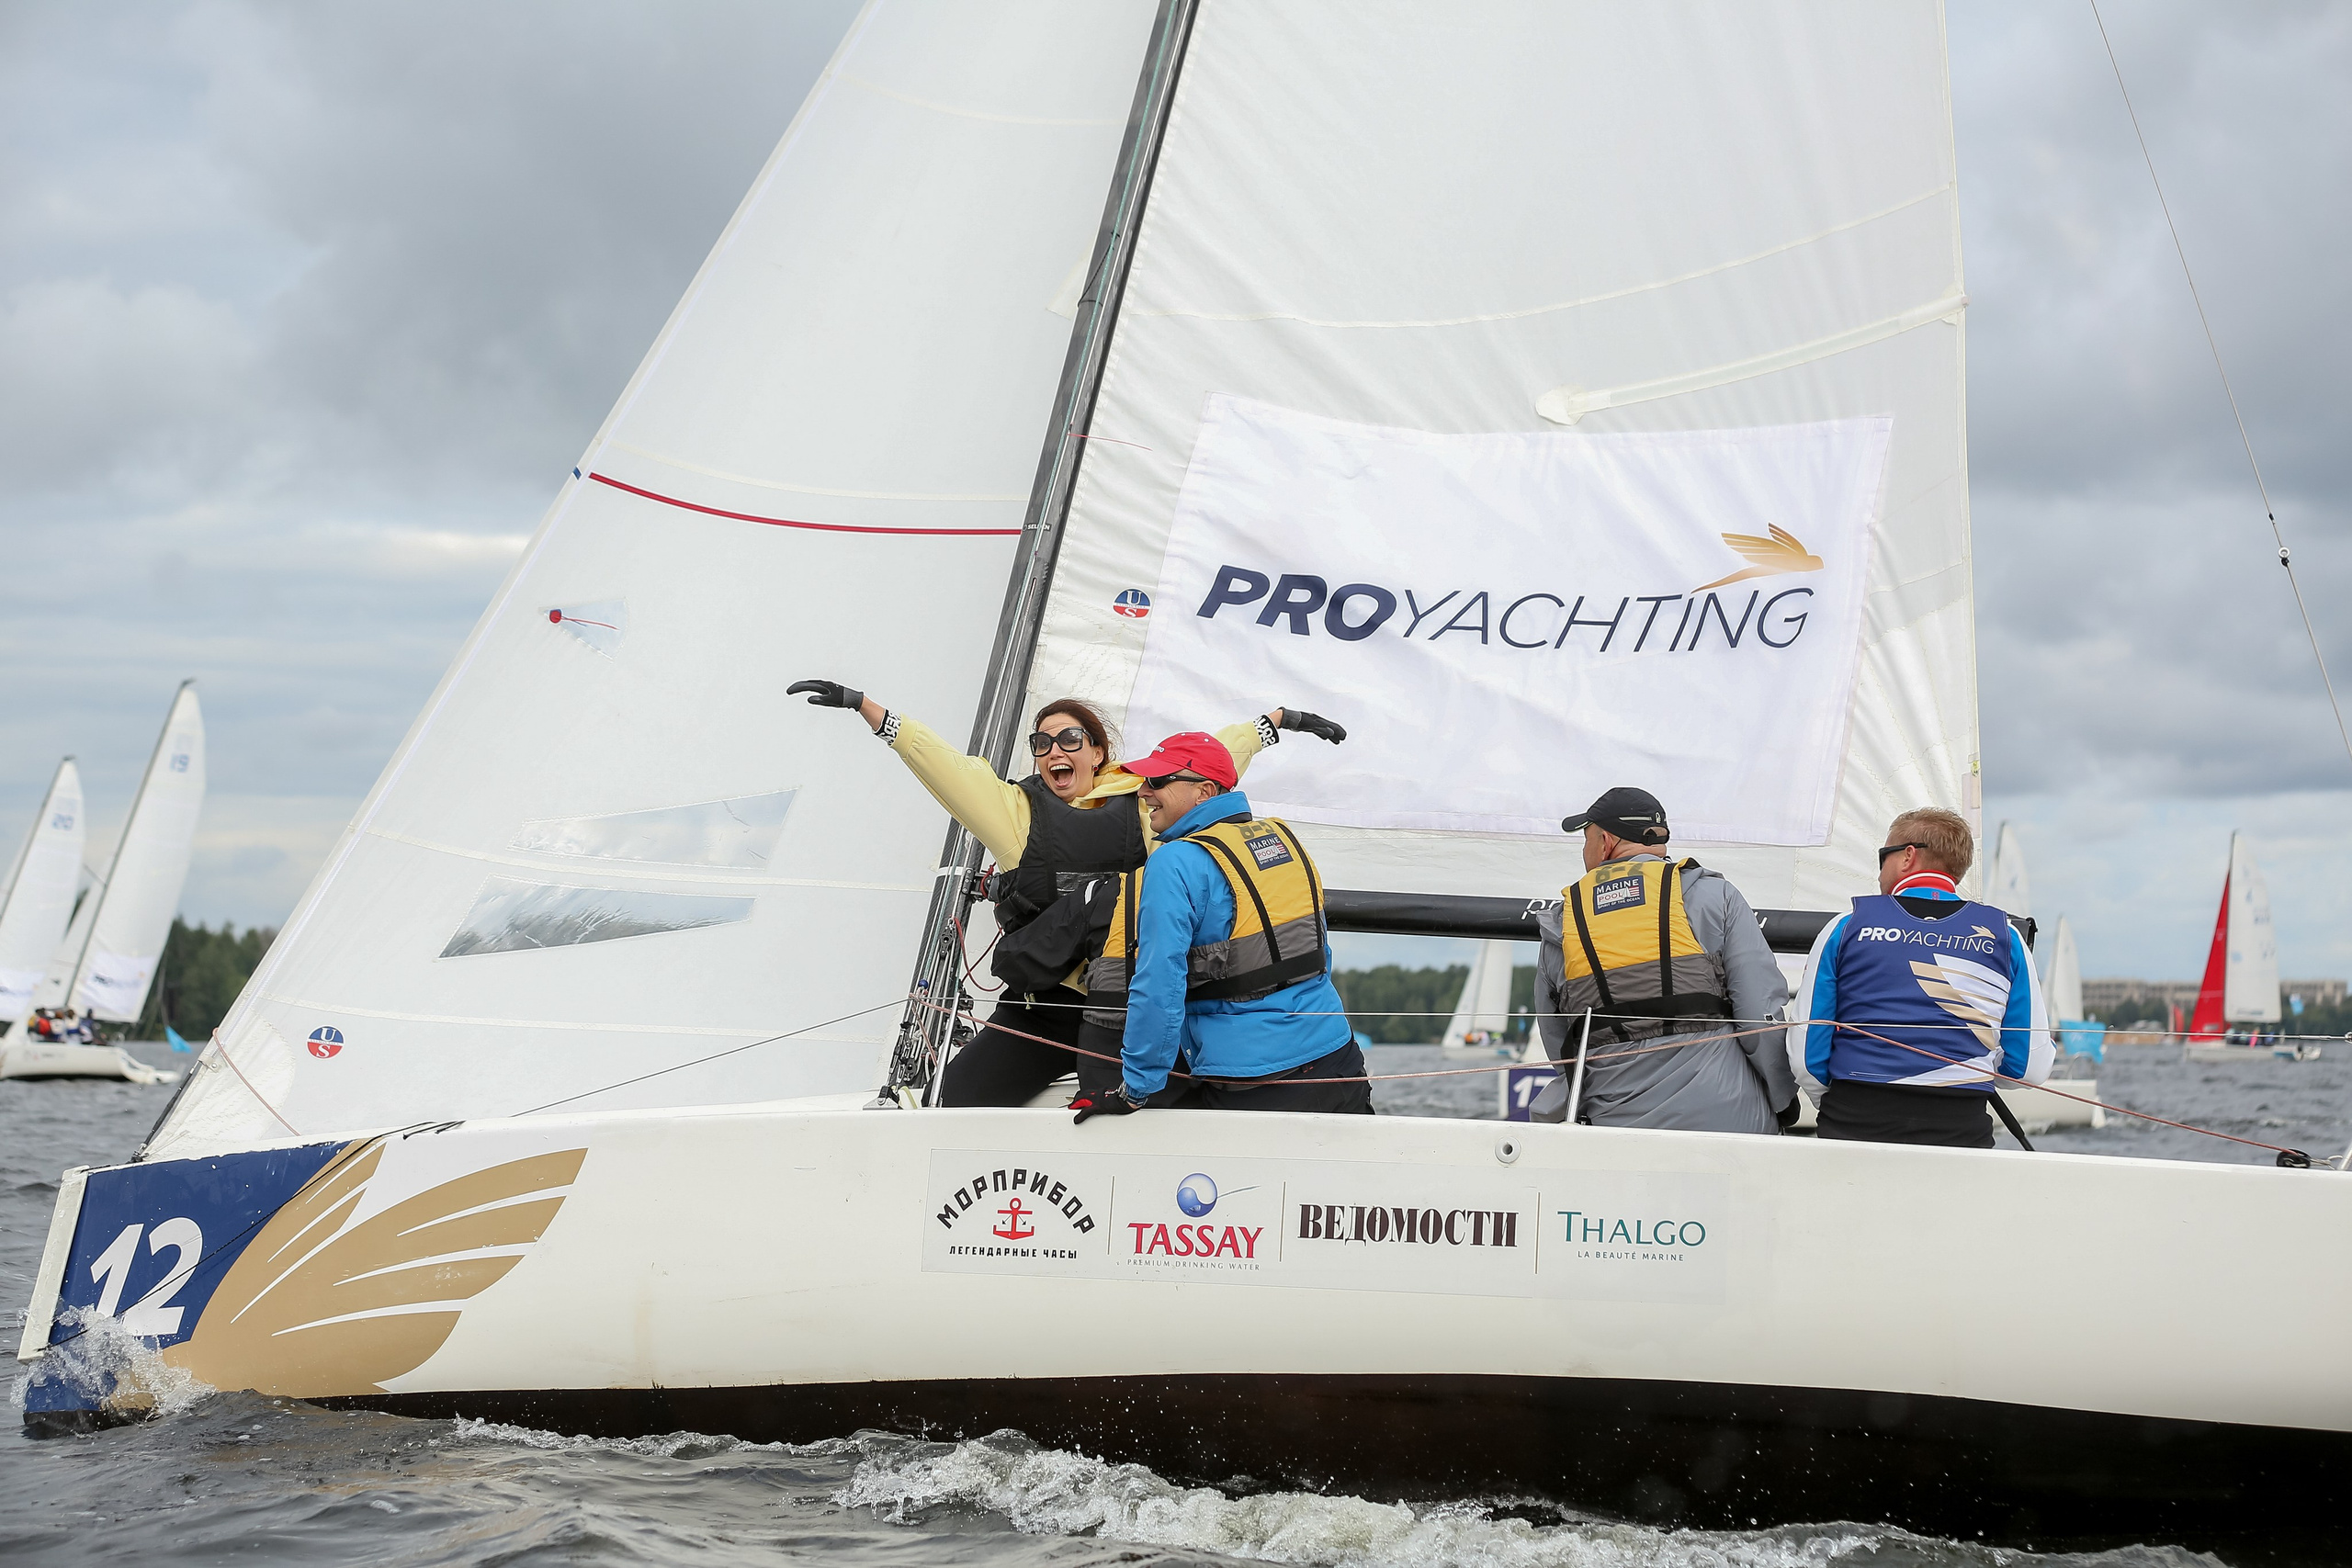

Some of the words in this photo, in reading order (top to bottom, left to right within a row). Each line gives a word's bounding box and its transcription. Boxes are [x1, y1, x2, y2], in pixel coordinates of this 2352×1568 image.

[1195, 564, 1815, 652] PROYACHTING
[1250, 836, 1281, 851] MARINE
[1256, 849, 1276, 858] POOL
[1596, 878, 1640, 895] MARINE
[1599, 893, 1623, 903] POOL
[1857, 927, 1996, 954] PROYACHTING
[936, 1168, 1095, 1235] МОРПРИБОР
[1297, 1203, 1520, 1248] ВЕДОМОСТИ
[1557, 1210, 1707, 1247] THALGO
[1126, 1223, 1265, 1258] TASSAY
[949, 1246, 1037, 1258] ЛЕГЕНДАРНЫЕ
[1043, 1248, 1077, 1259] ЧАСЫ
[1577, 1250, 1590, 1259] LA
[1595, 1250, 1637, 1261] BEAUTÉ
[1642, 1253, 1685, 1262] MARINE
[1127, 1258, 1170, 1268] PREMIUM
[1175, 1260, 1224, 1269] DRINKING
[1229, 1263, 1261, 1271] WATER
[90, 1216, 204, 1337] 12
